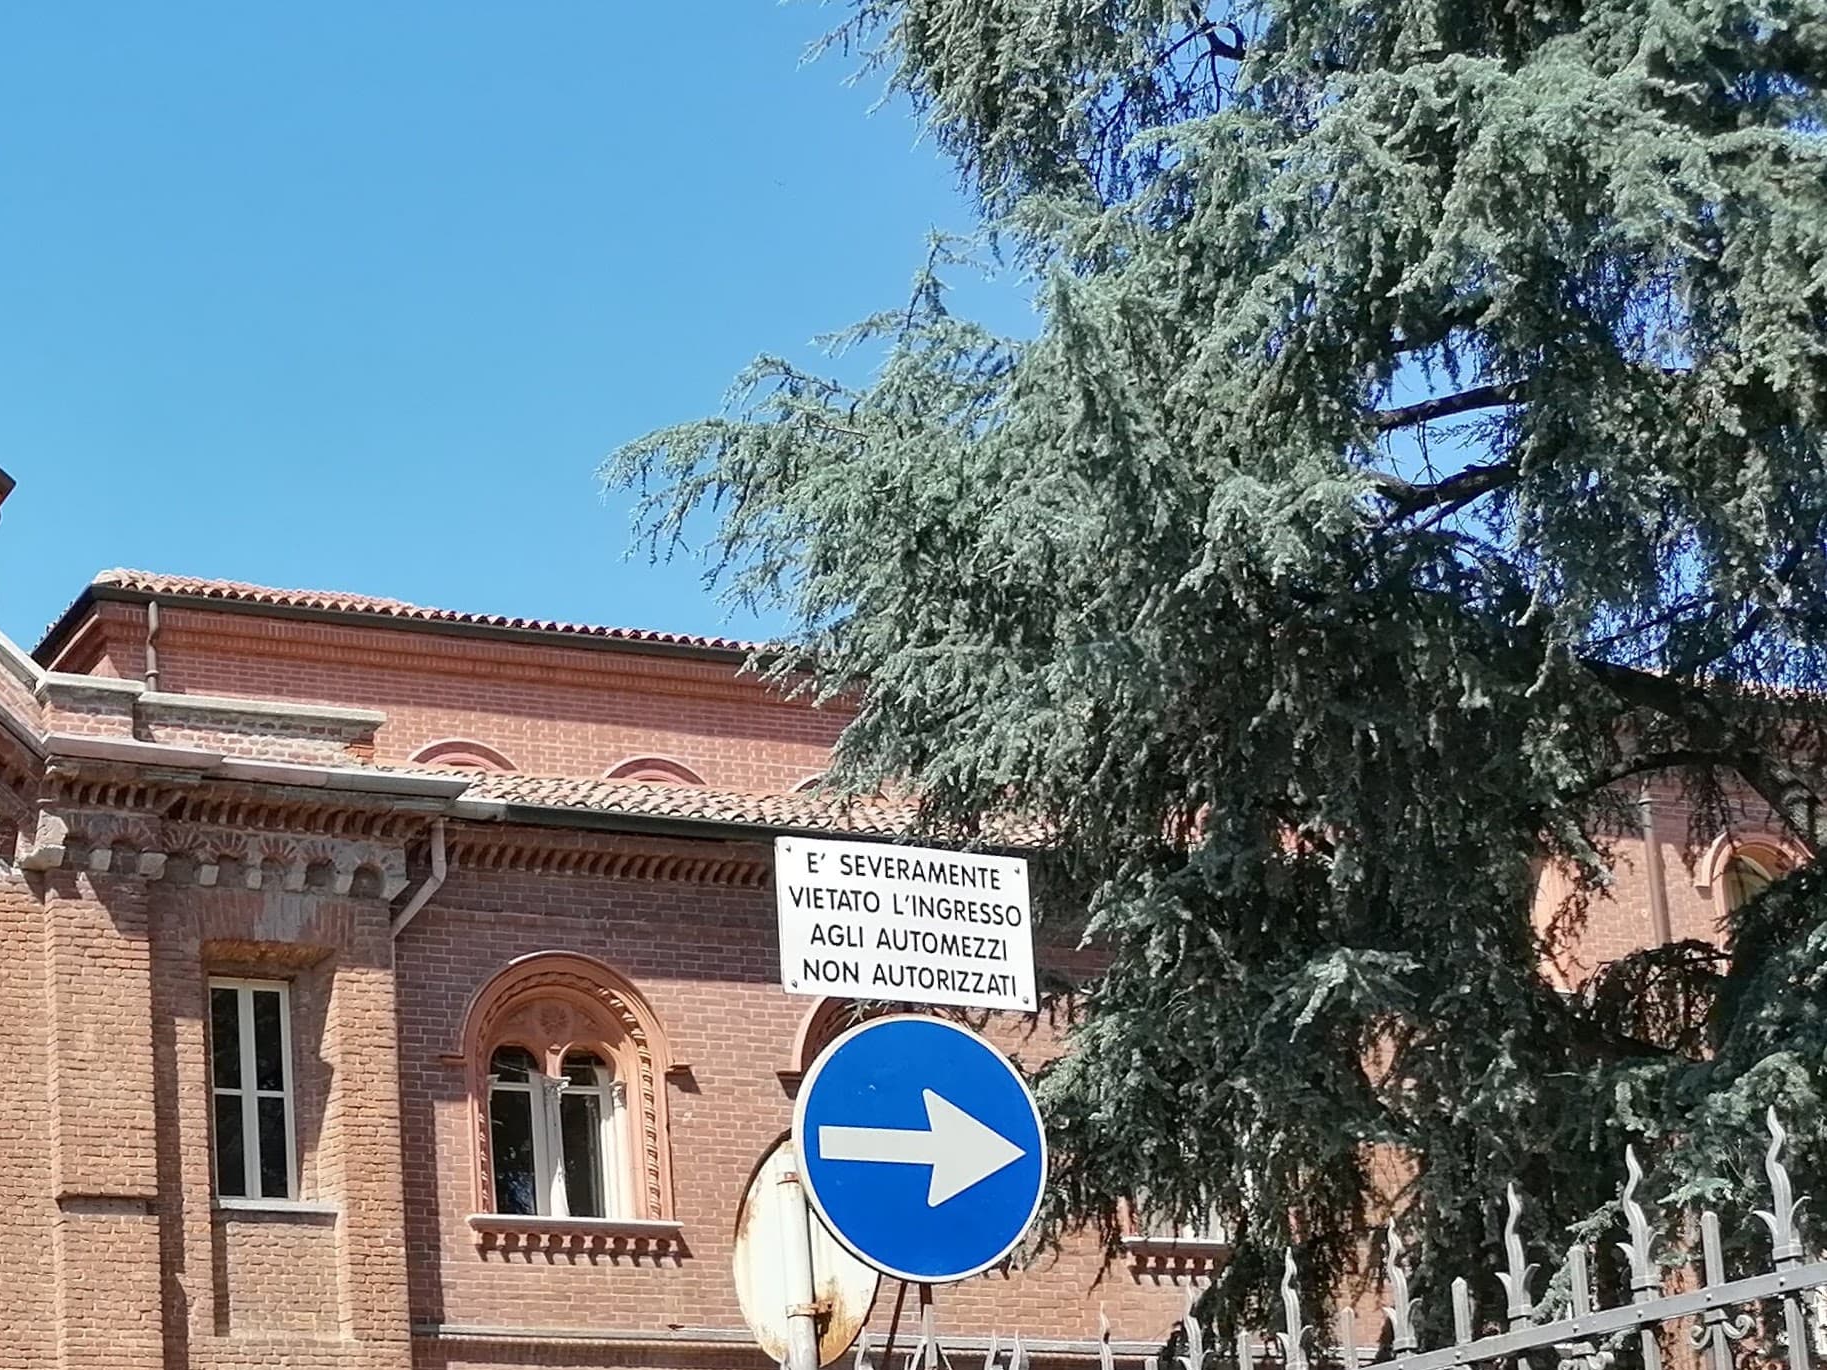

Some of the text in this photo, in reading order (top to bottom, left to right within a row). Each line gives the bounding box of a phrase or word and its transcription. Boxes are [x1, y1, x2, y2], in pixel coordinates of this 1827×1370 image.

[807, 852, 1001, 890] E' SEVERAMENTE
[789, 886, 1022, 927] VIETATO L'INGRESSO
[810, 924, 1008, 961] AGLI AUTOMEZZI
[803, 959, 1017, 998] NON AUTORIZZATI
